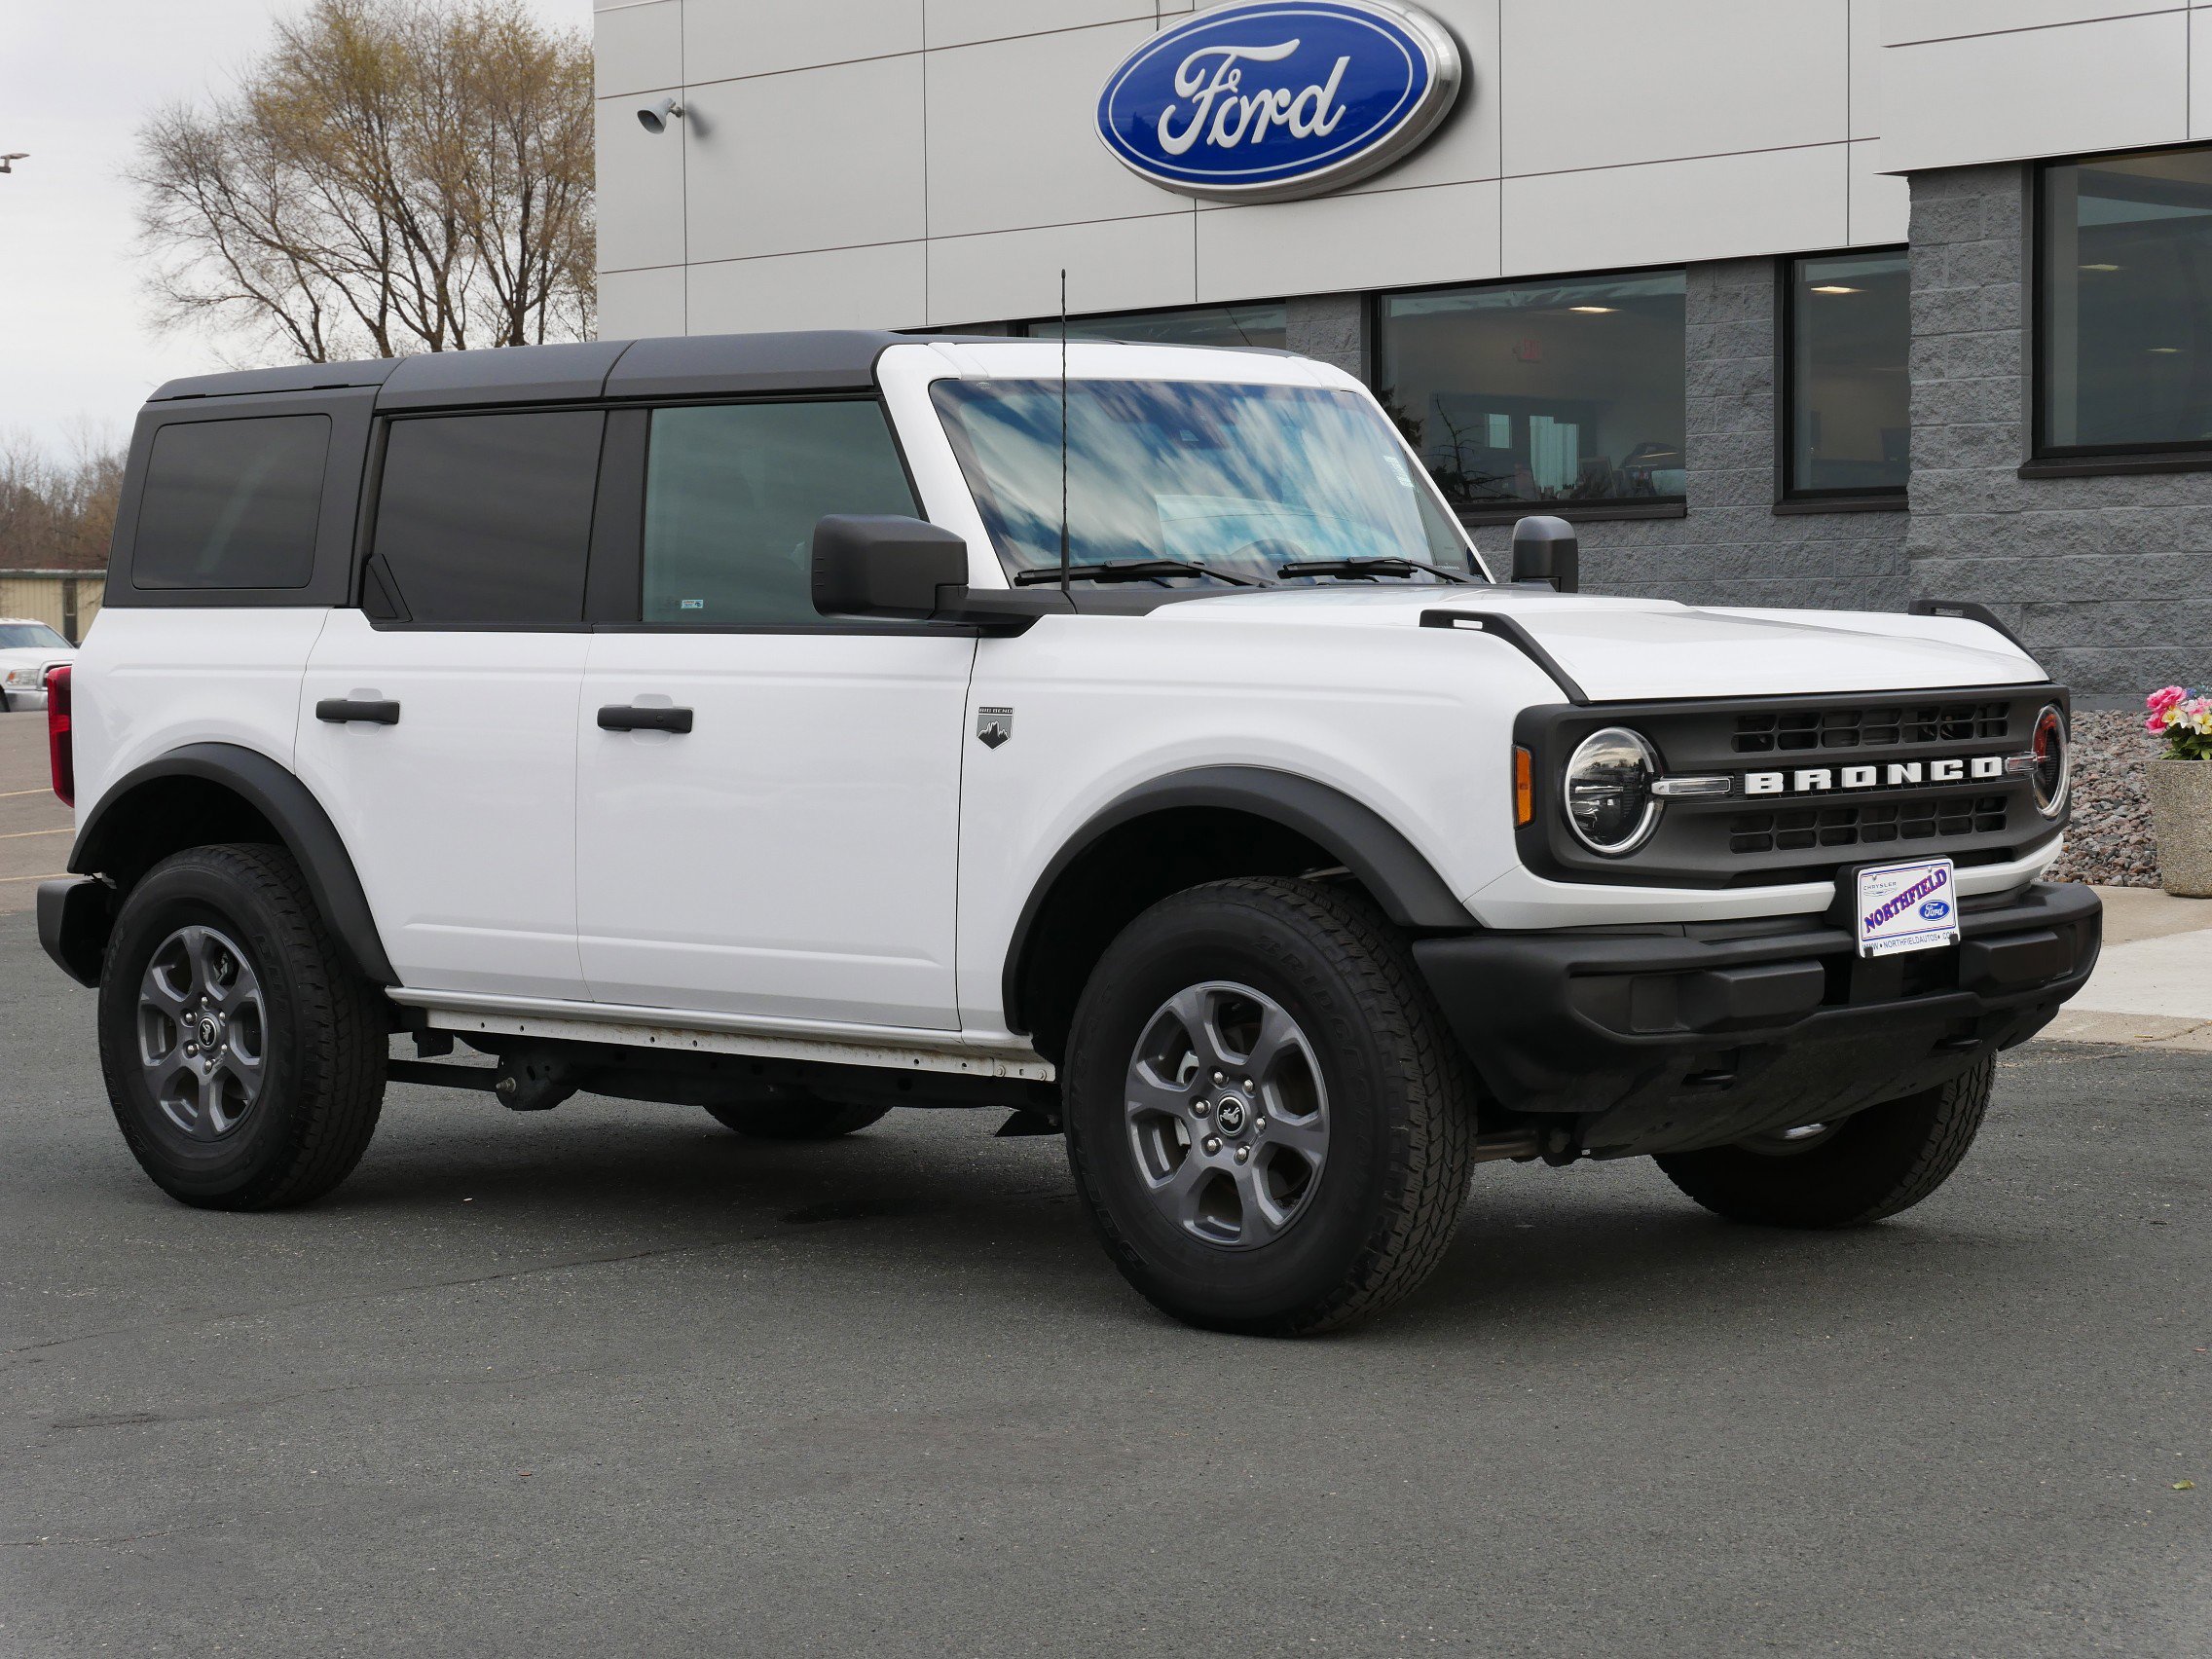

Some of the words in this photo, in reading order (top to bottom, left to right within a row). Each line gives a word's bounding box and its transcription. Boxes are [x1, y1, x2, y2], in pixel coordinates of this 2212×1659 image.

[1158, 39, 1350, 156] Ford
[1745, 756, 2002, 794] BRONCO
[1863, 881, 1898, 891] CHRYSLER
[1864, 868, 1947, 934] NORTHFIELD
[1924, 902, 1944, 917] Ford
